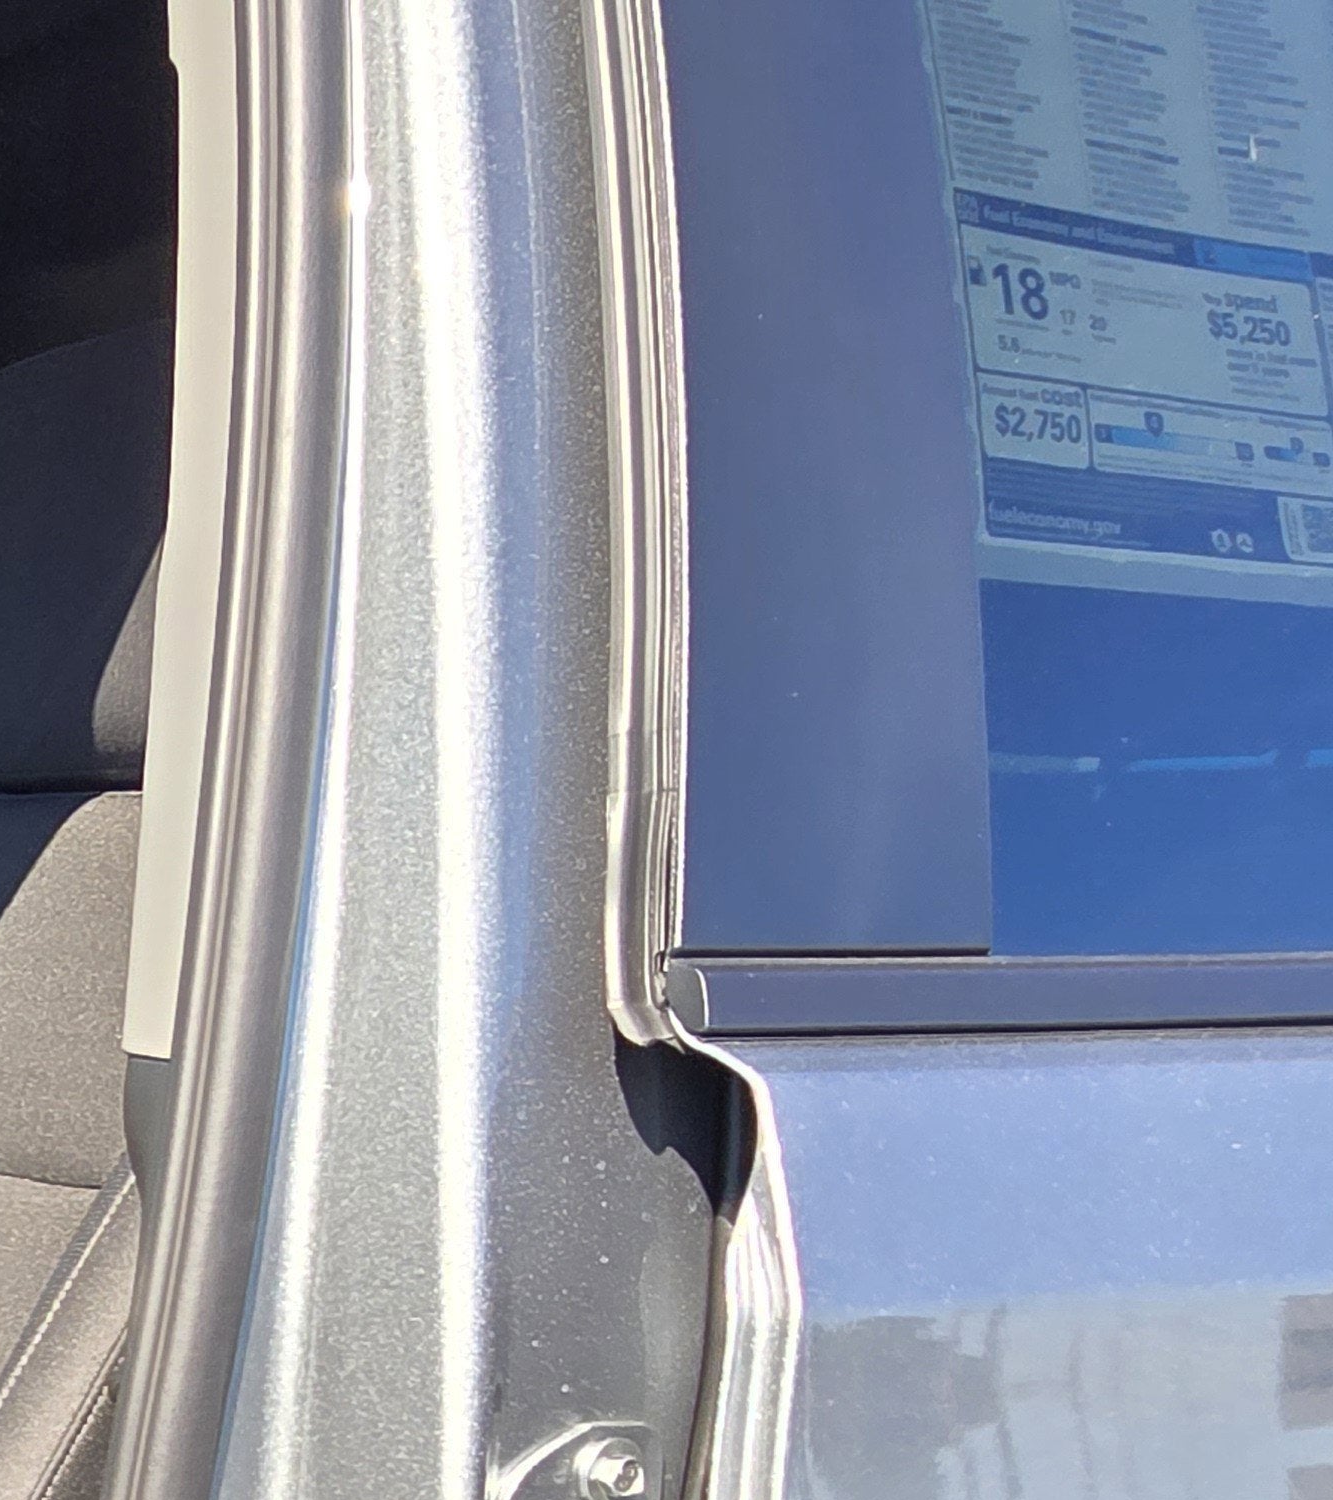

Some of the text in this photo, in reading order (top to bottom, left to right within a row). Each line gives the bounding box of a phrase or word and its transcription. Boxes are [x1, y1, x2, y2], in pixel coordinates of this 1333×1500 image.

[992, 262, 1049, 321] 18
[1207, 308, 1291, 346] $5,250
[994, 402, 1081, 444] $2,750
